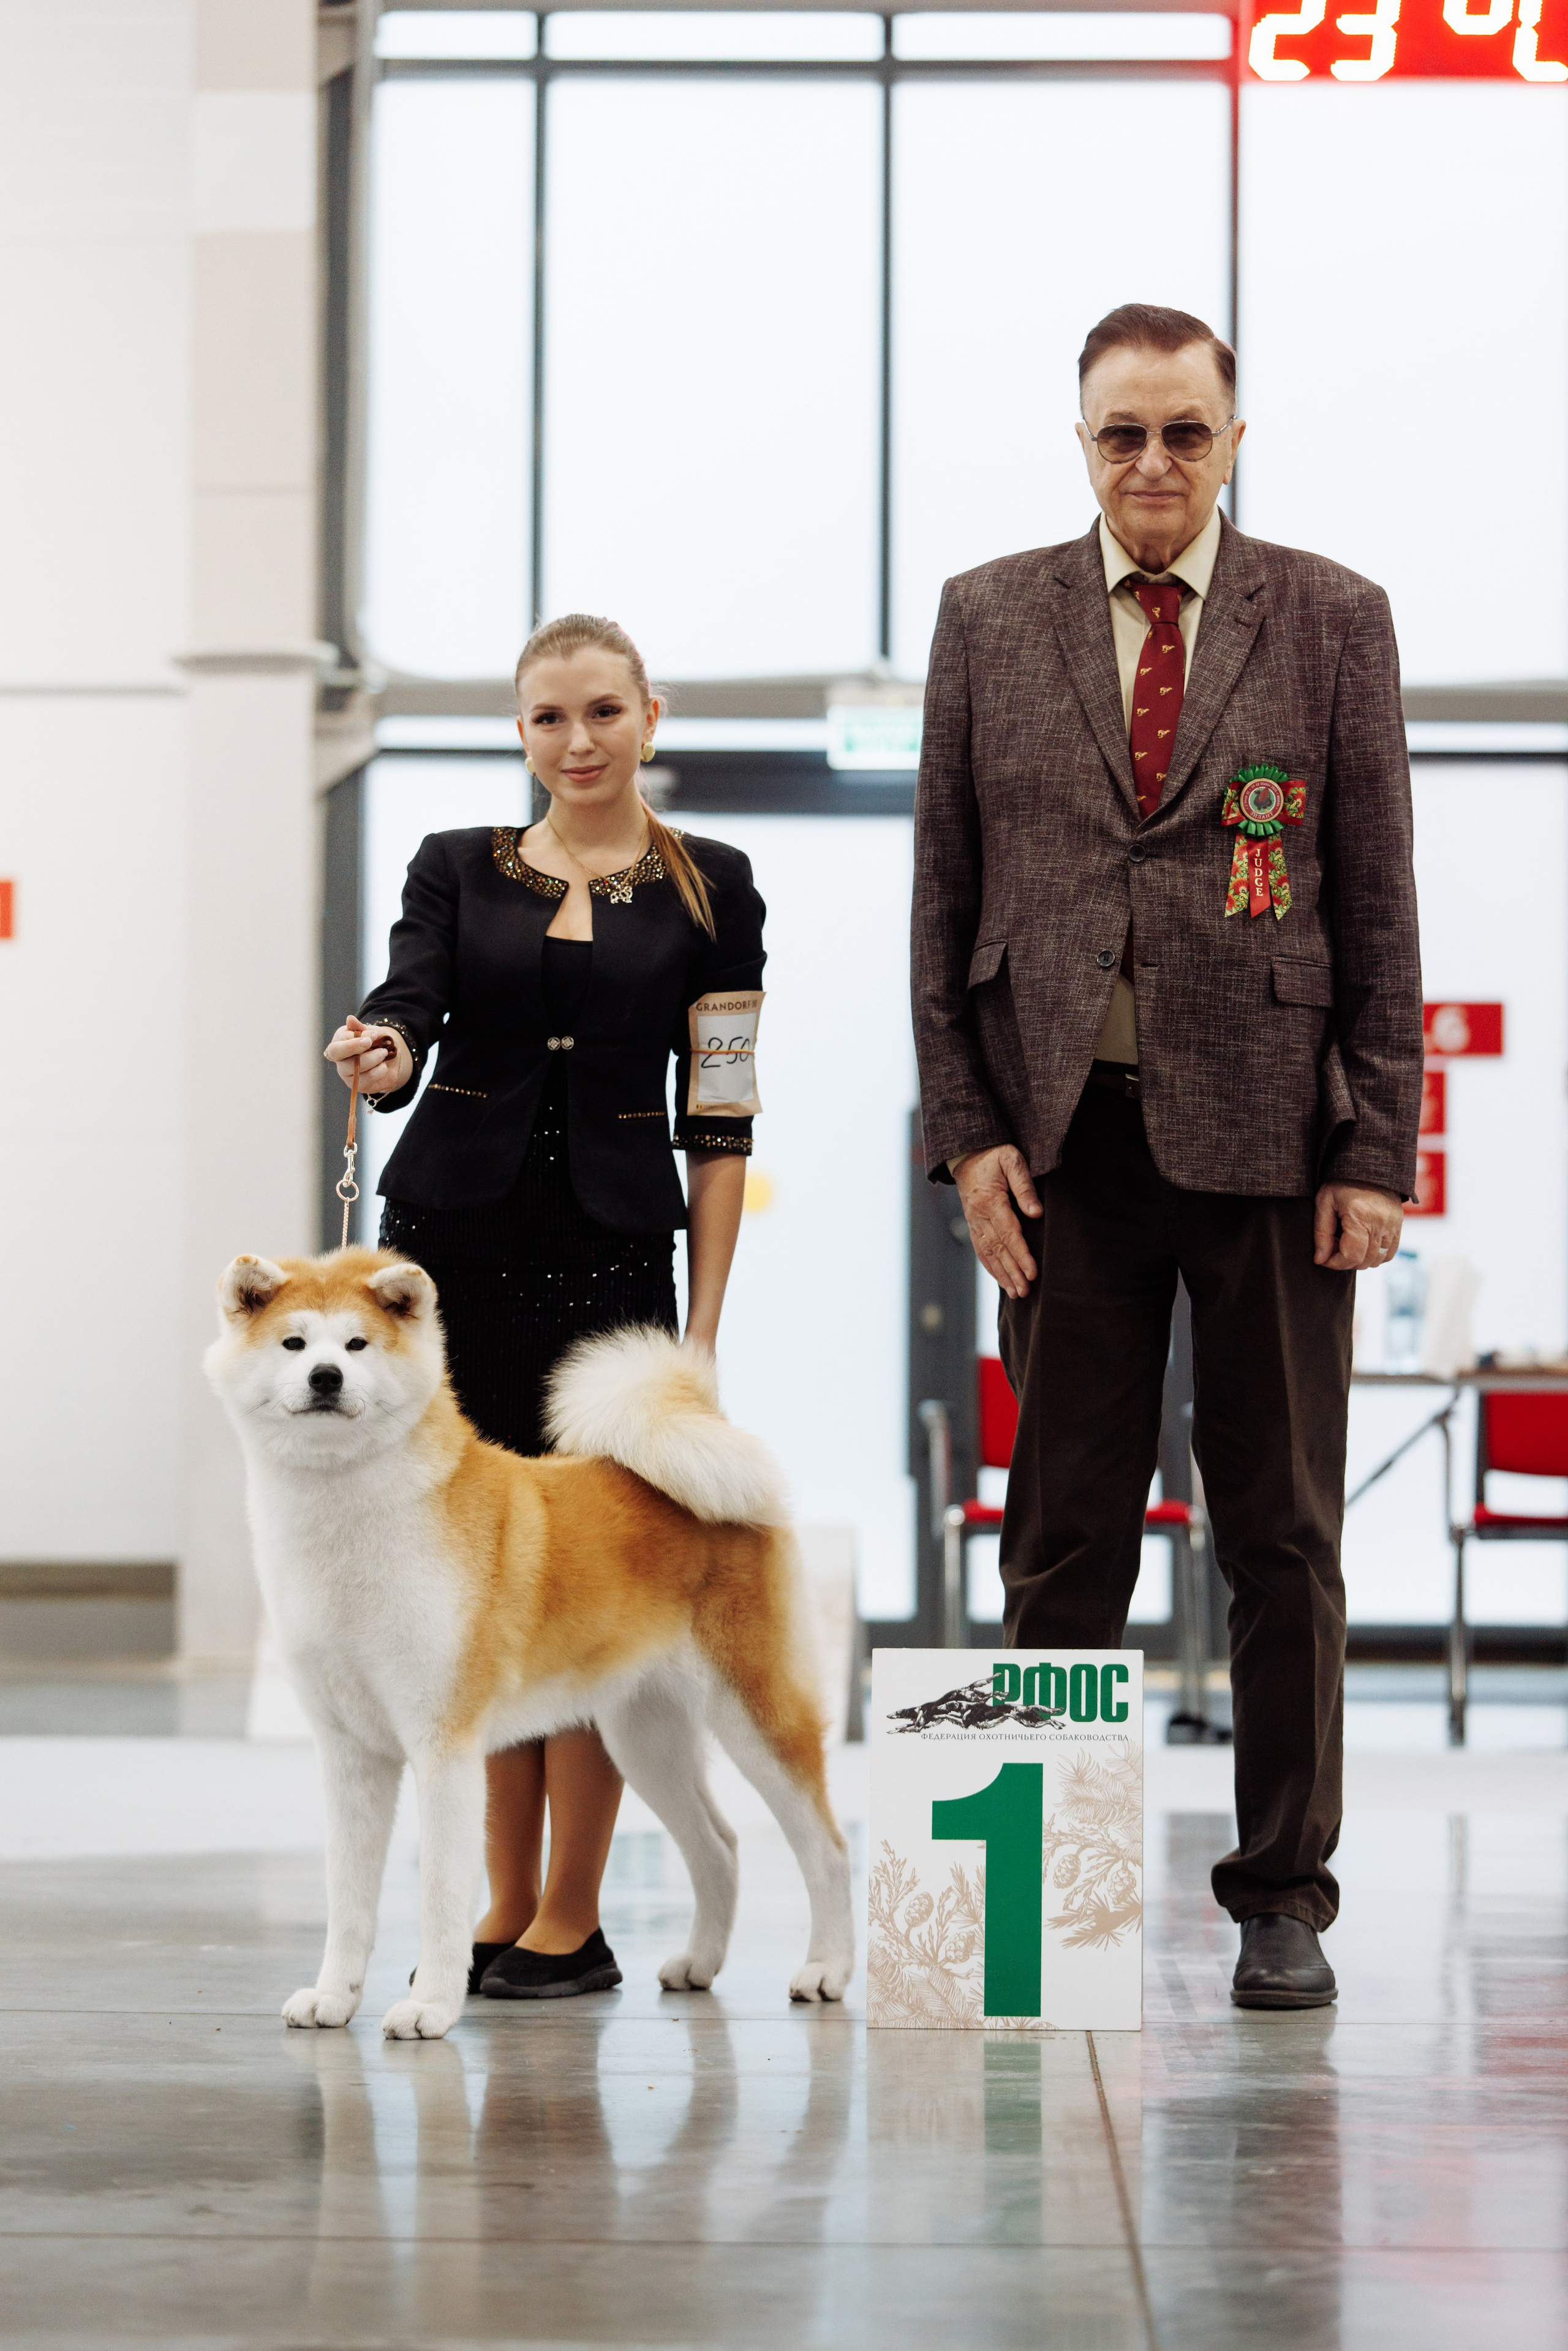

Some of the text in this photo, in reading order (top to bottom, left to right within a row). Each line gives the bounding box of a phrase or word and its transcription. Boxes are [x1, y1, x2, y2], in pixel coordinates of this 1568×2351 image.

[1254, 848, 1264, 897] JUDGE
[696, 1000, 751, 1011] GRANDORF
[701, 1036, 751, 1068] 250
[992, 1662, 1129, 1723] РФОС
[1049, 1734, 1129, 1742] СОБАКОВОДСТВА
[931, 1762, 1044, 2017] 1
